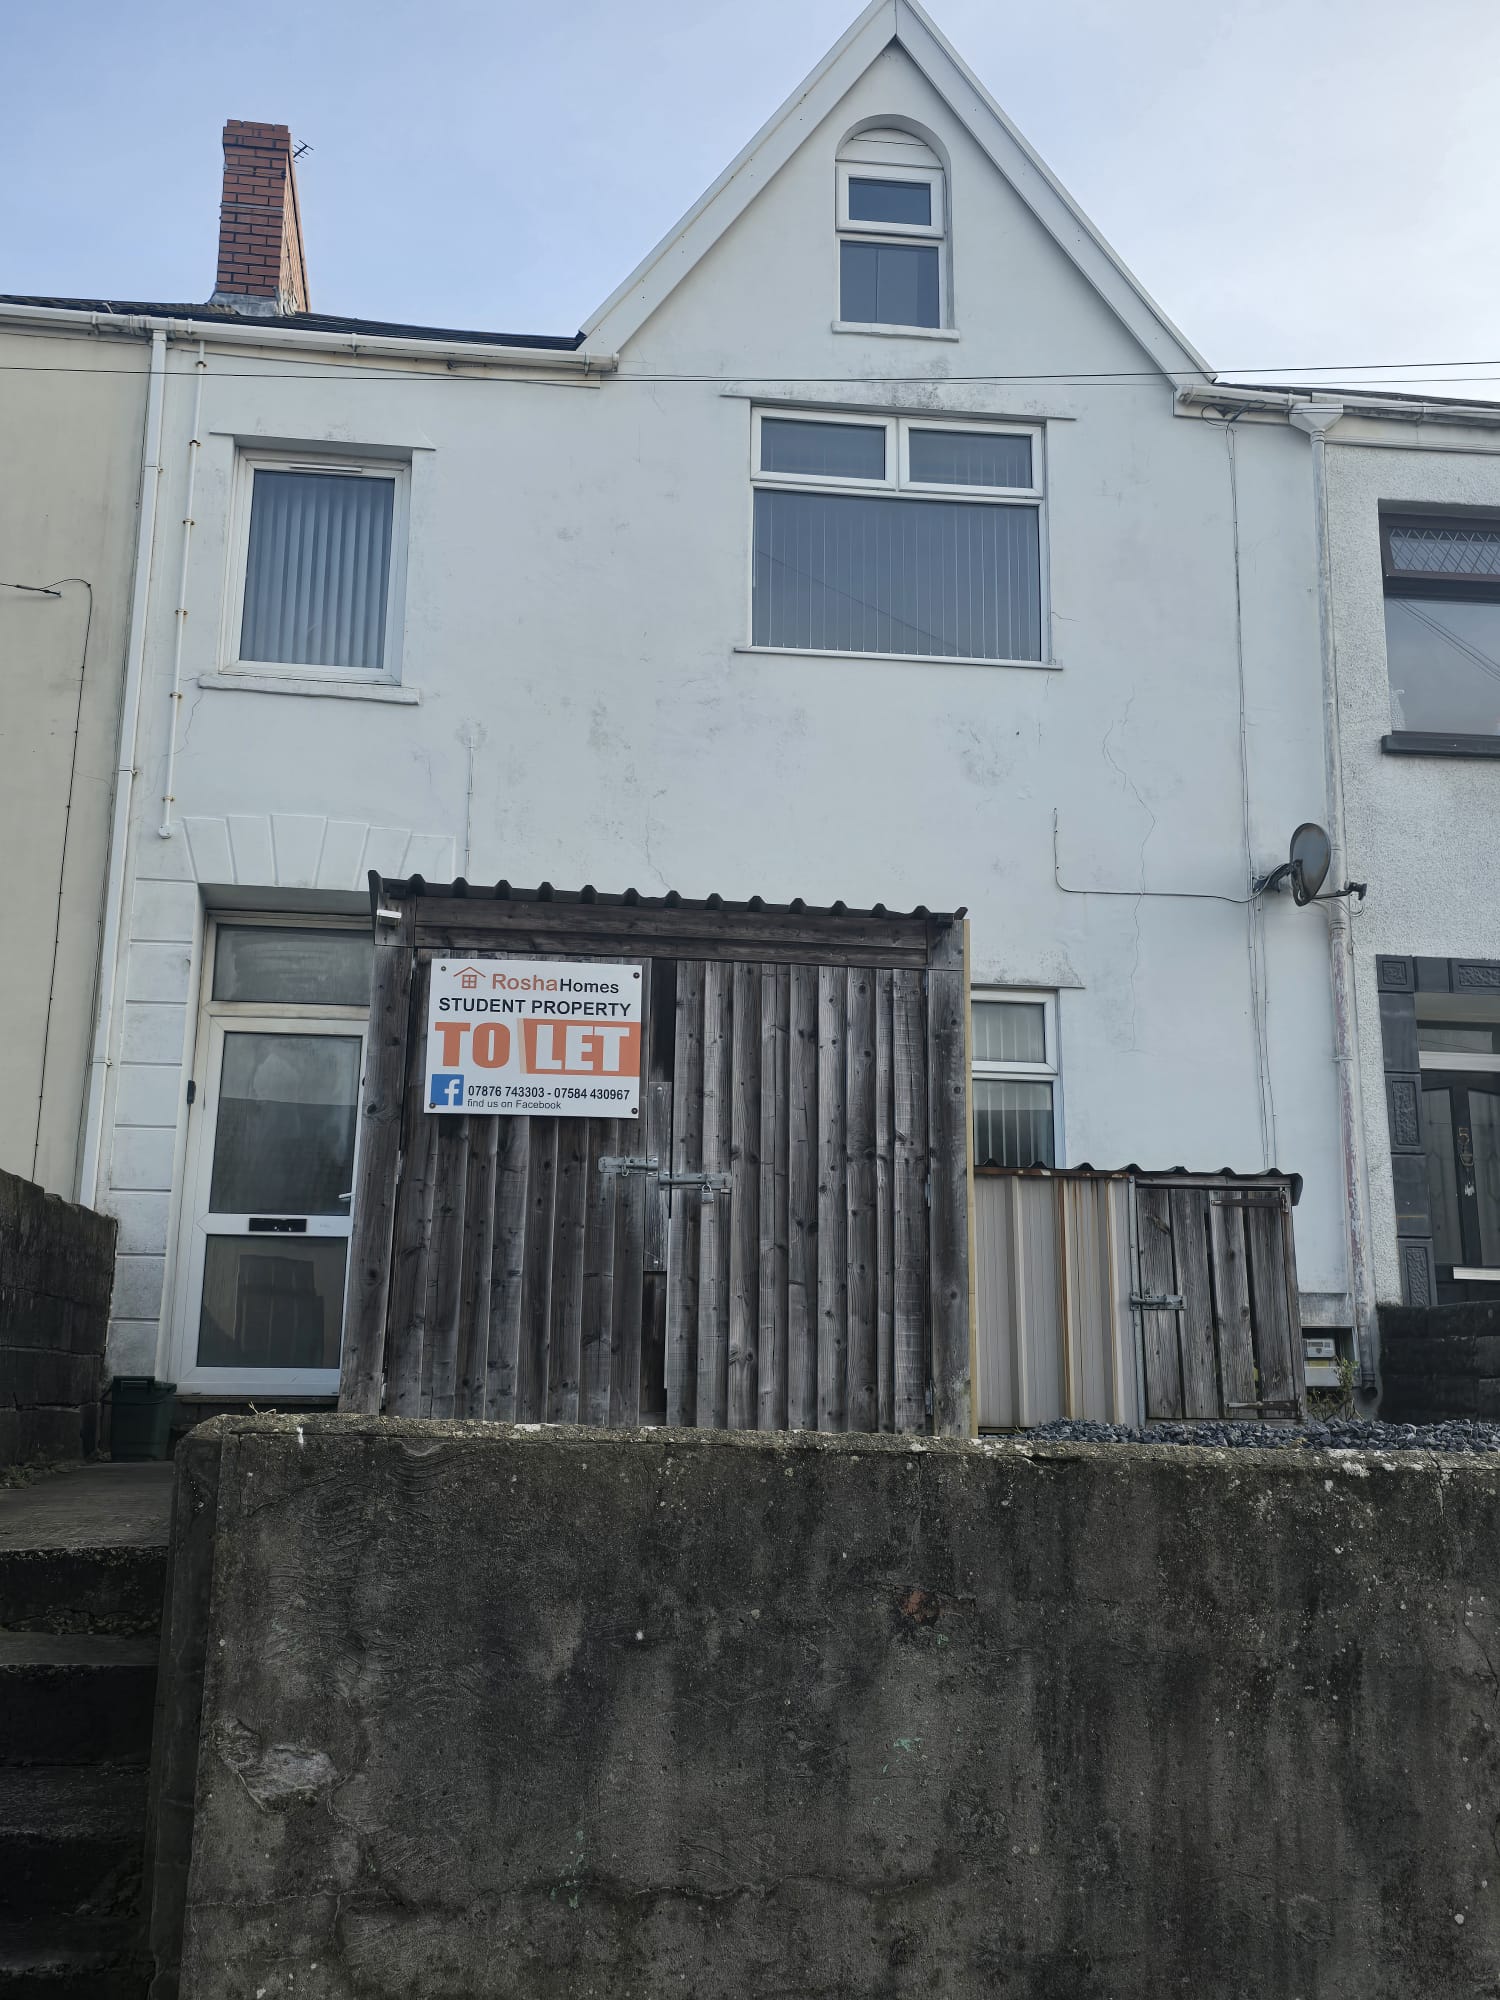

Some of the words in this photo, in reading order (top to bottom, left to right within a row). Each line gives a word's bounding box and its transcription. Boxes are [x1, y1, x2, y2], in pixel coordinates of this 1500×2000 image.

[438, 997, 526, 1013] STUDENT
[531, 1000, 632, 1017] PROPERTY
[434, 1022, 511, 1069] TO
[535, 1024, 630, 1072] LET
[468, 1085, 502, 1097] 07876
[505, 1086, 545, 1098] 743303
[554, 1087, 588, 1099] 07584
[589, 1088, 630, 1100] 430967
[467, 1099, 485, 1108] find
[487, 1100, 499, 1108] us
[516, 1100, 562, 1110] Facebook
